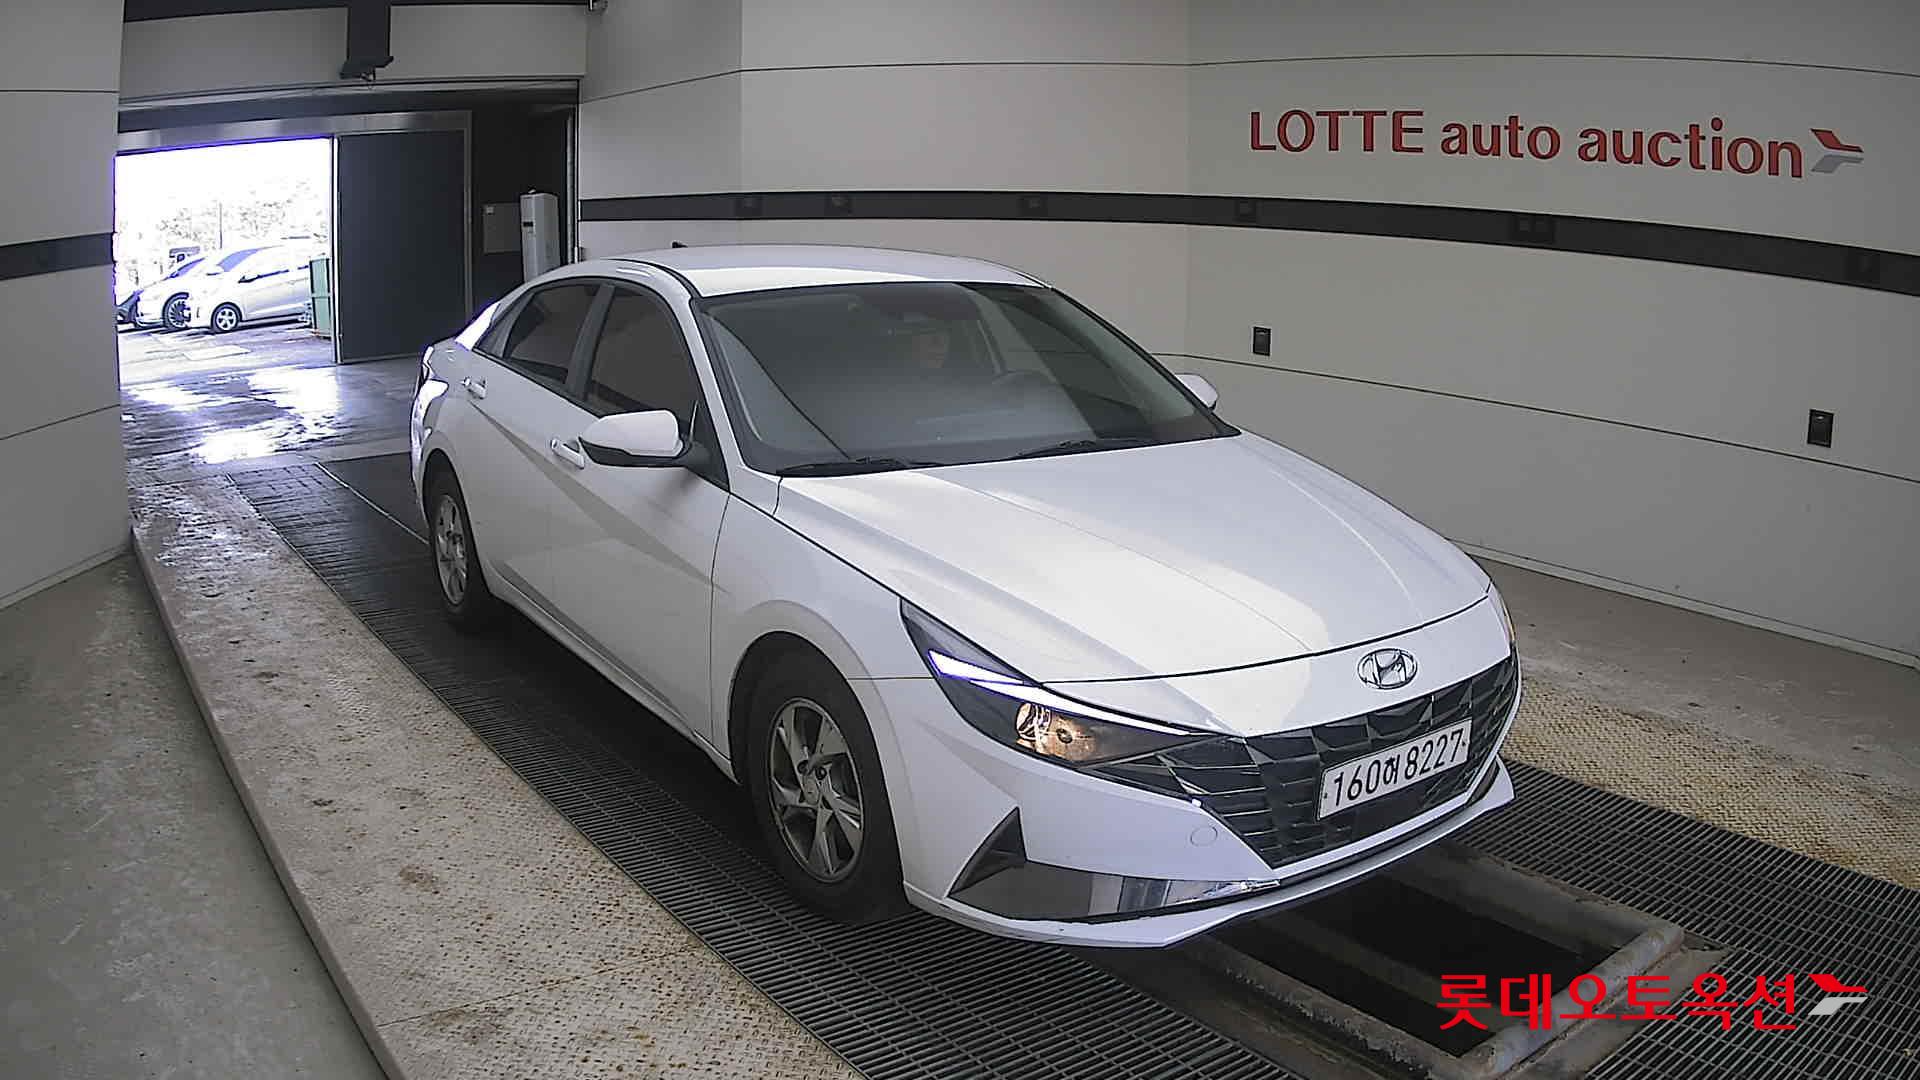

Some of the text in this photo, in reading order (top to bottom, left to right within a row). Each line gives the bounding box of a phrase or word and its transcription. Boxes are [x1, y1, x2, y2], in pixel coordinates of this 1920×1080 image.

[1250, 110, 1804, 178] LOTTE auto auction
